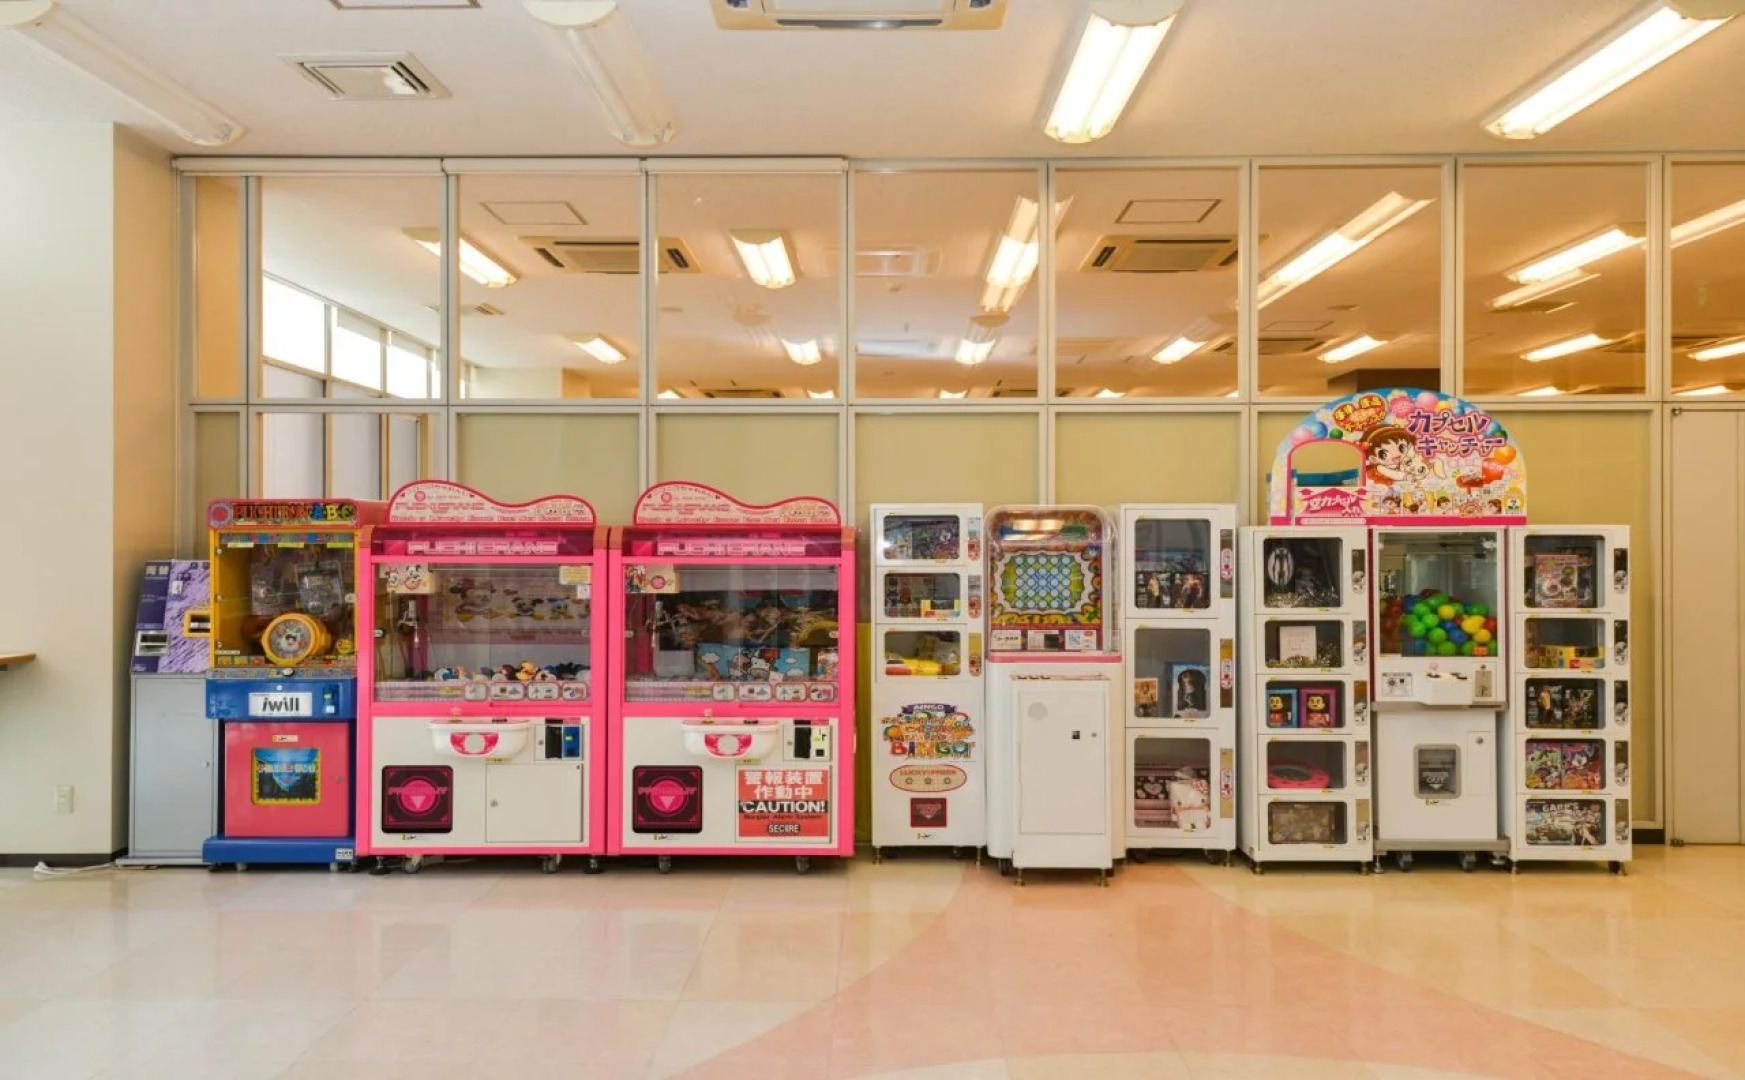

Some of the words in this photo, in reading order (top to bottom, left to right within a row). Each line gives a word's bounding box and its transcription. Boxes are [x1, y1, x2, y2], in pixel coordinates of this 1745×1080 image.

[1408, 411, 1490, 432] カプセル
[1417, 437, 1502, 455] キャッチャー
[262, 697, 299, 712] iwill
[891, 740, 969, 755] BINGO
[745, 771, 822, 784] 警報装置
[754, 785, 813, 799] 作動中
[742, 801, 826, 812] CAUTION!
